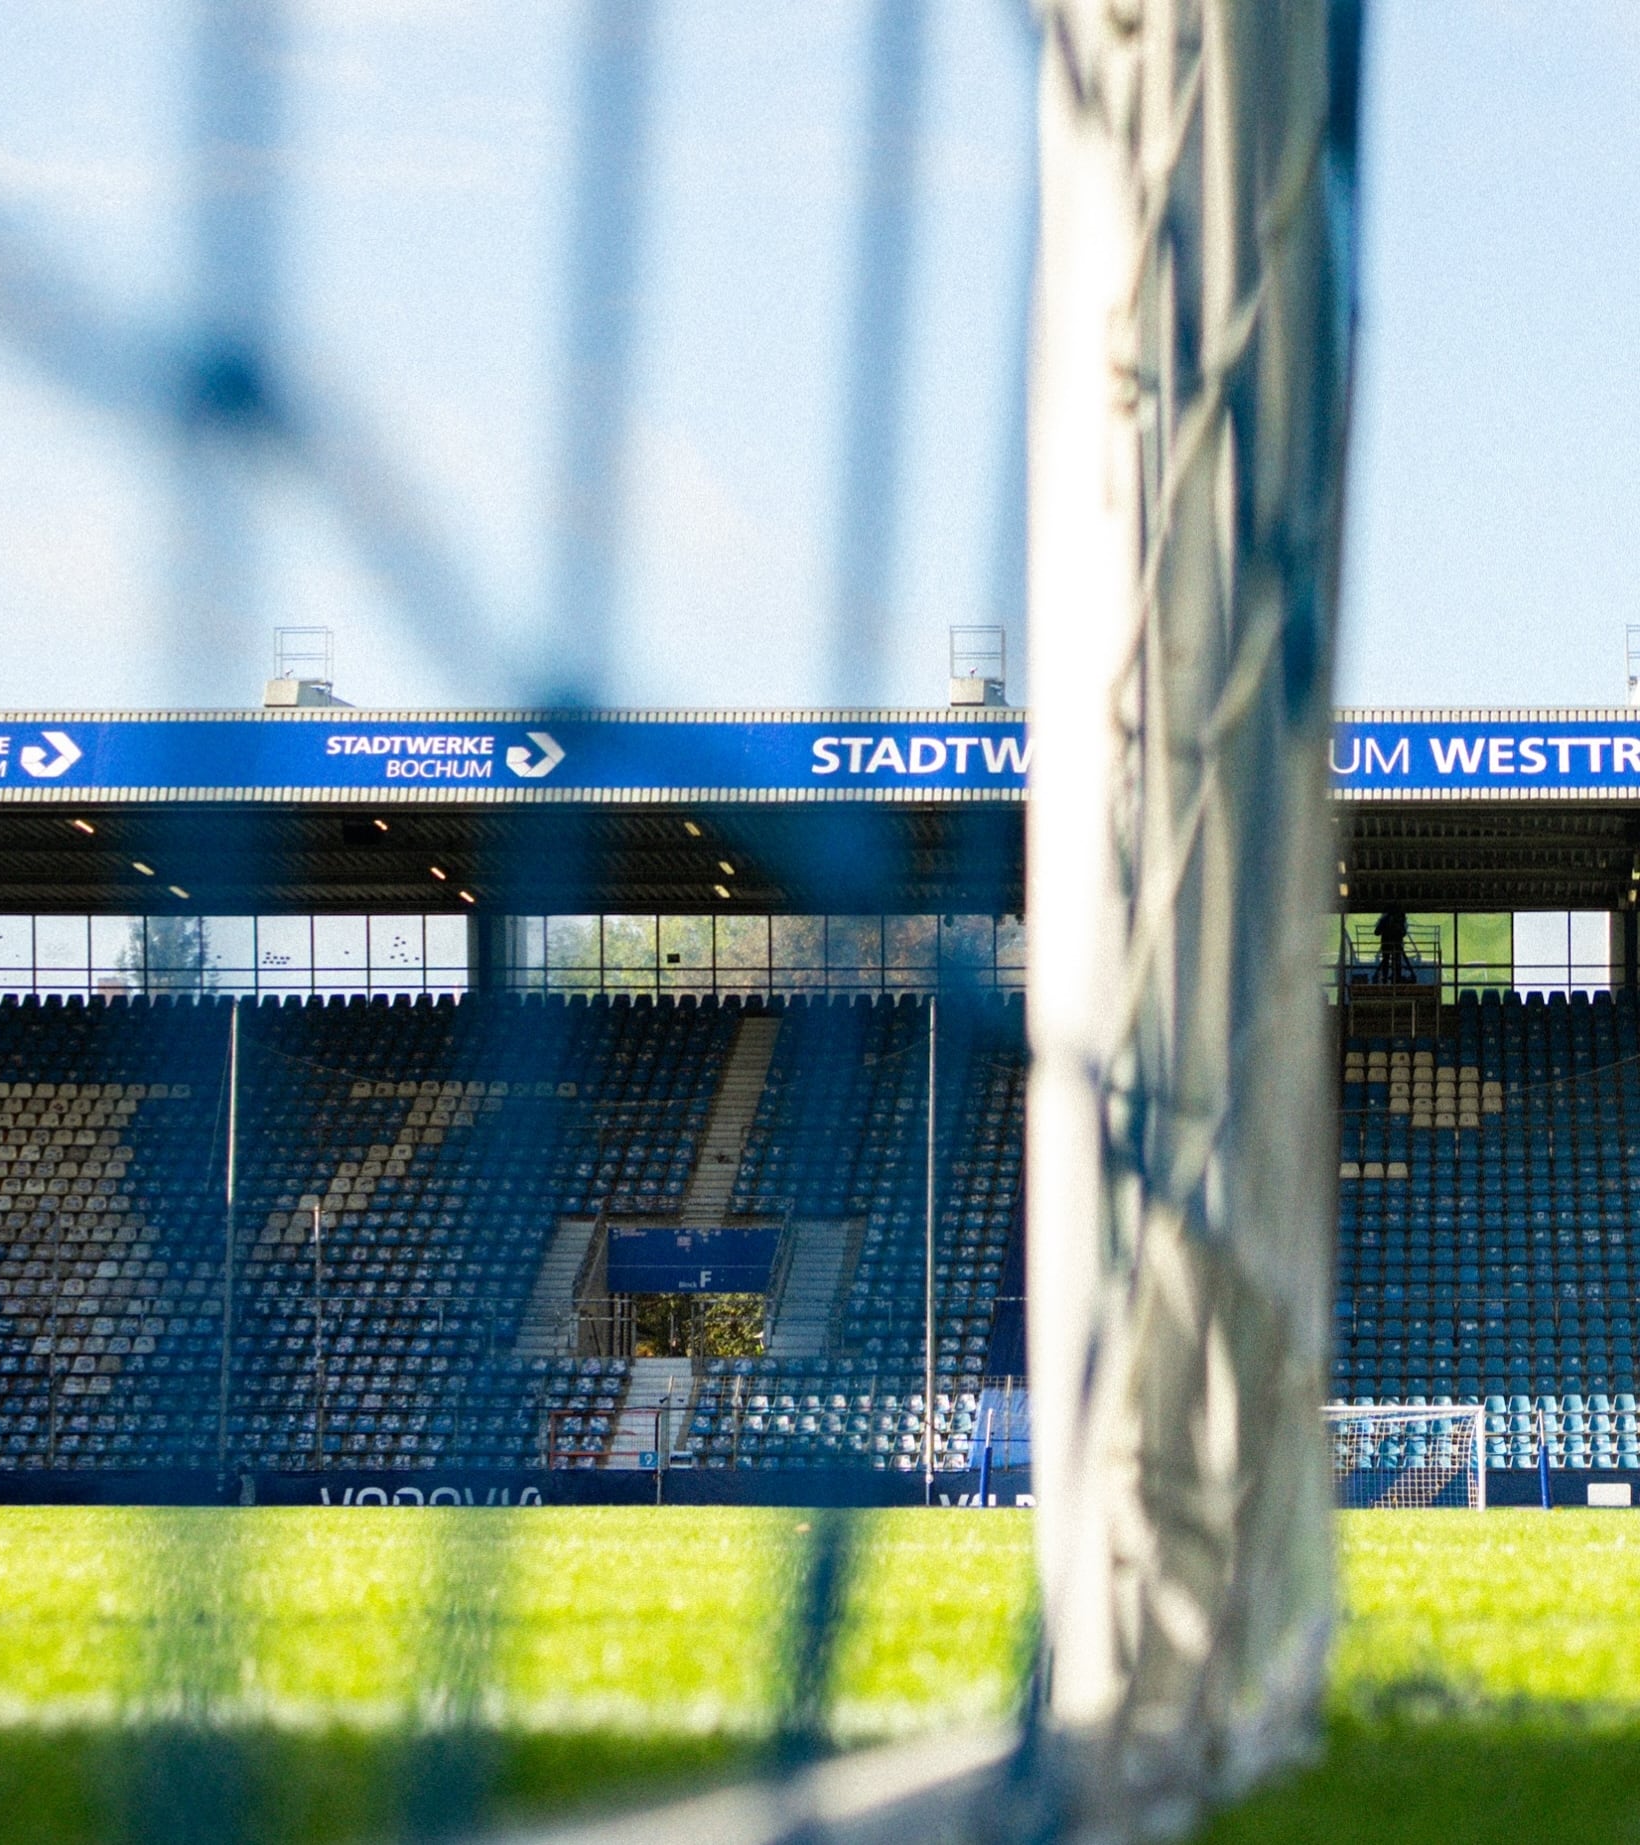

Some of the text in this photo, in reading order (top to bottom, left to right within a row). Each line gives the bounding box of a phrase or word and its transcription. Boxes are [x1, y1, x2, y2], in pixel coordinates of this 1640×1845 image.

[326, 735, 495, 755] STADTWERKE
[386, 759, 492, 779] BOCHUM
[699, 1270, 712, 1288] F
